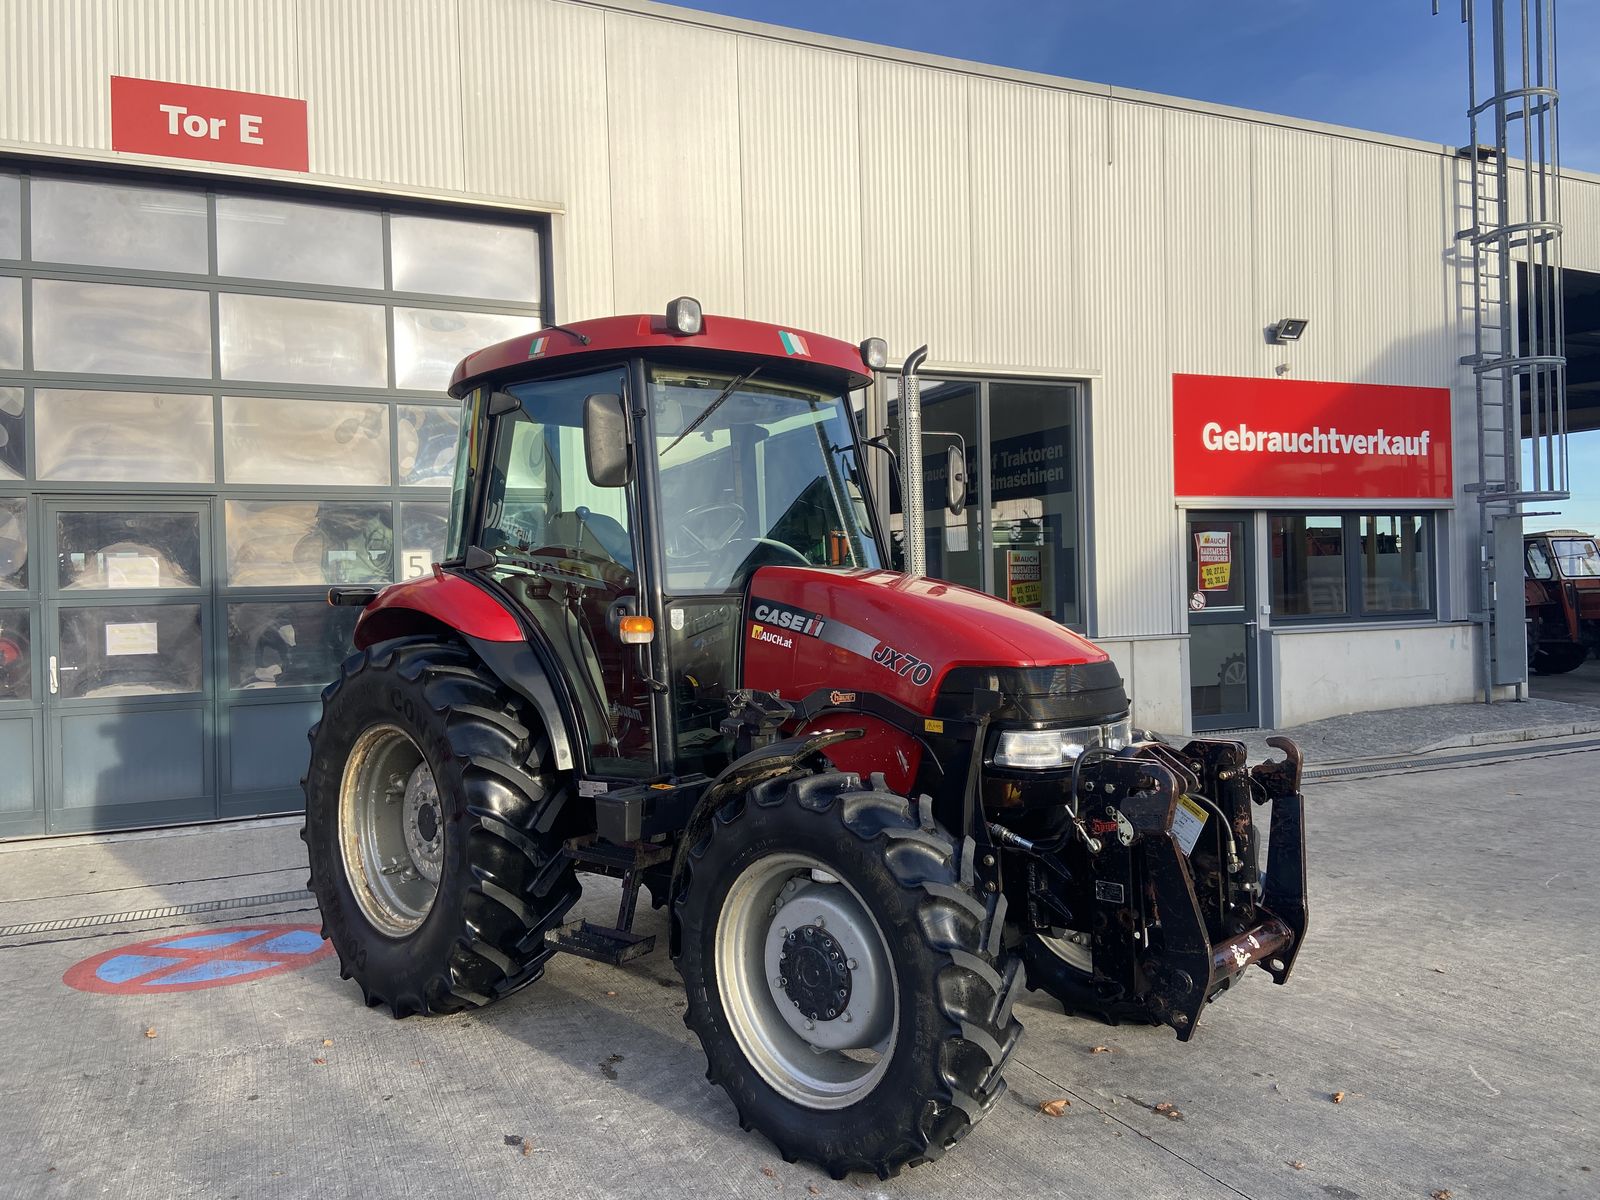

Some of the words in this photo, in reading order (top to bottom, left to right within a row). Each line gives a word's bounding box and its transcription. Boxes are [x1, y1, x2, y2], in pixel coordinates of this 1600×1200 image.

[159, 104, 227, 141] Tor
[240, 114, 264, 145] E
[1201, 421, 1430, 457] Gebrauchtverkauf
[1001, 444, 1064, 468] Traktoren
[968, 466, 1064, 494] Ladmaschinen
[1204, 536, 1226, 545] MAUCH
[409, 556, 425, 579] 5
[754, 604, 806, 631] CASE
[753, 626, 793, 649] MAUCH.at
[872, 646, 933, 686] JX70
